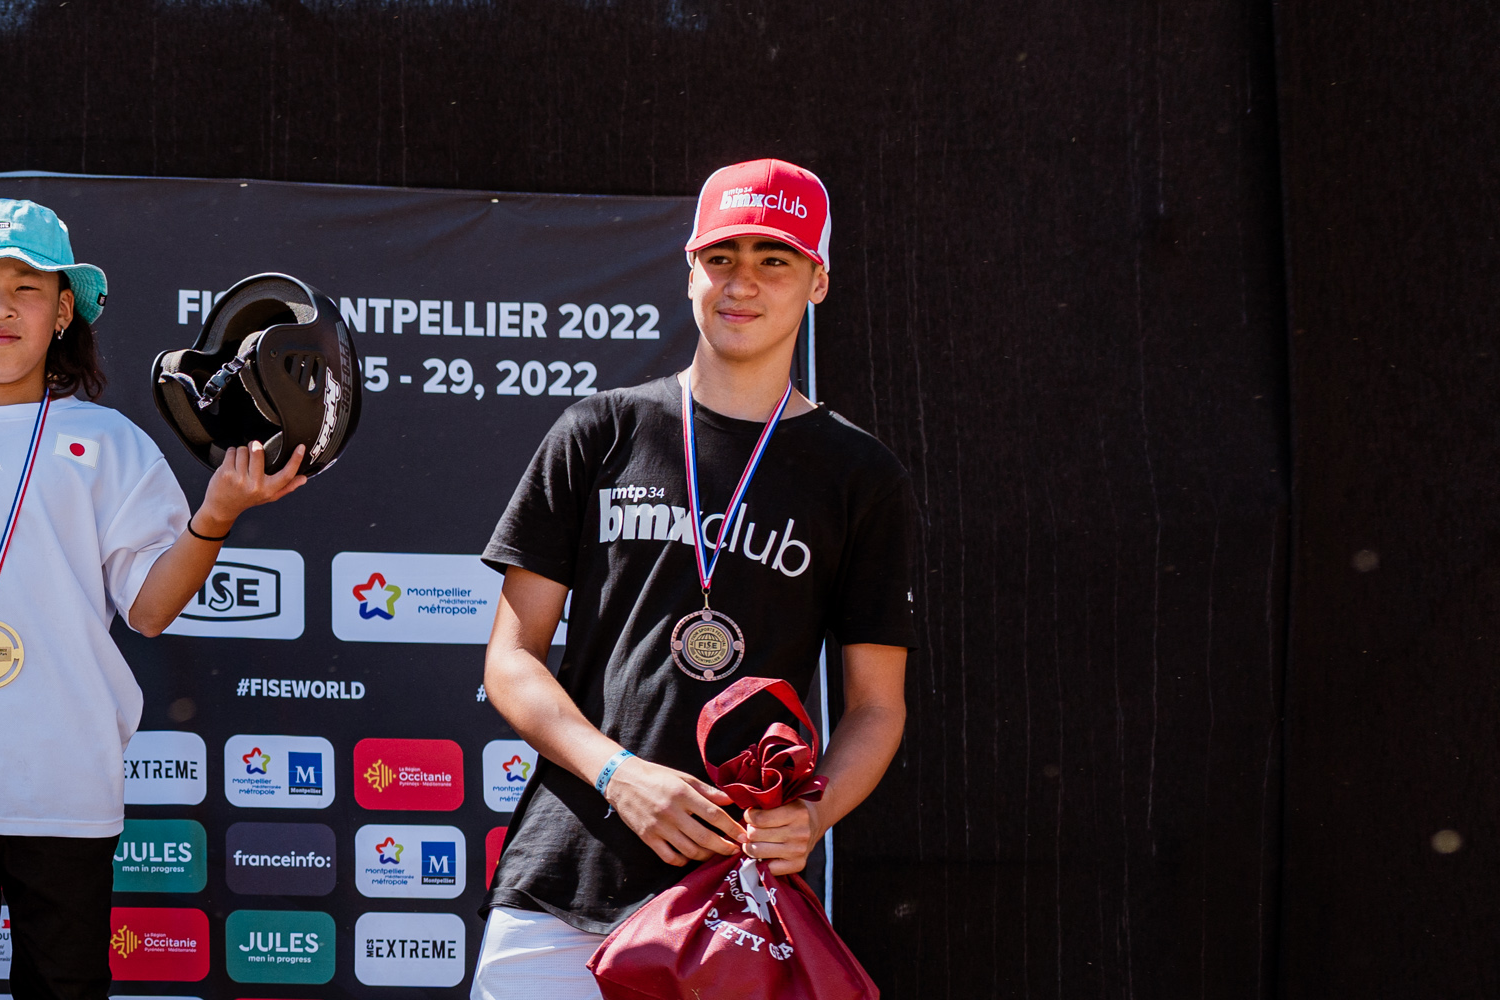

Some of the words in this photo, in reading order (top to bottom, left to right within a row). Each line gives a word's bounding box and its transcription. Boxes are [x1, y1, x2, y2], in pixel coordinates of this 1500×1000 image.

[558, 303, 660, 339] 2022
[422, 358, 485, 401] 29,
[495, 360, 597, 397] 2022
[698, 641, 717, 649] FISE
[237, 678, 365, 699] #FISEWORLD
[399, 772, 451, 782] Occitanie
[113, 842, 192, 862] JULES
[233, 850, 331, 867] franceinfo:
[151, 866, 184, 874] progress
[144, 938, 197, 947] Occitanie
[239, 932, 319, 953] JULES
[376, 939, 456, 959] EXTREME
[277, 956, 311, 964] progress
